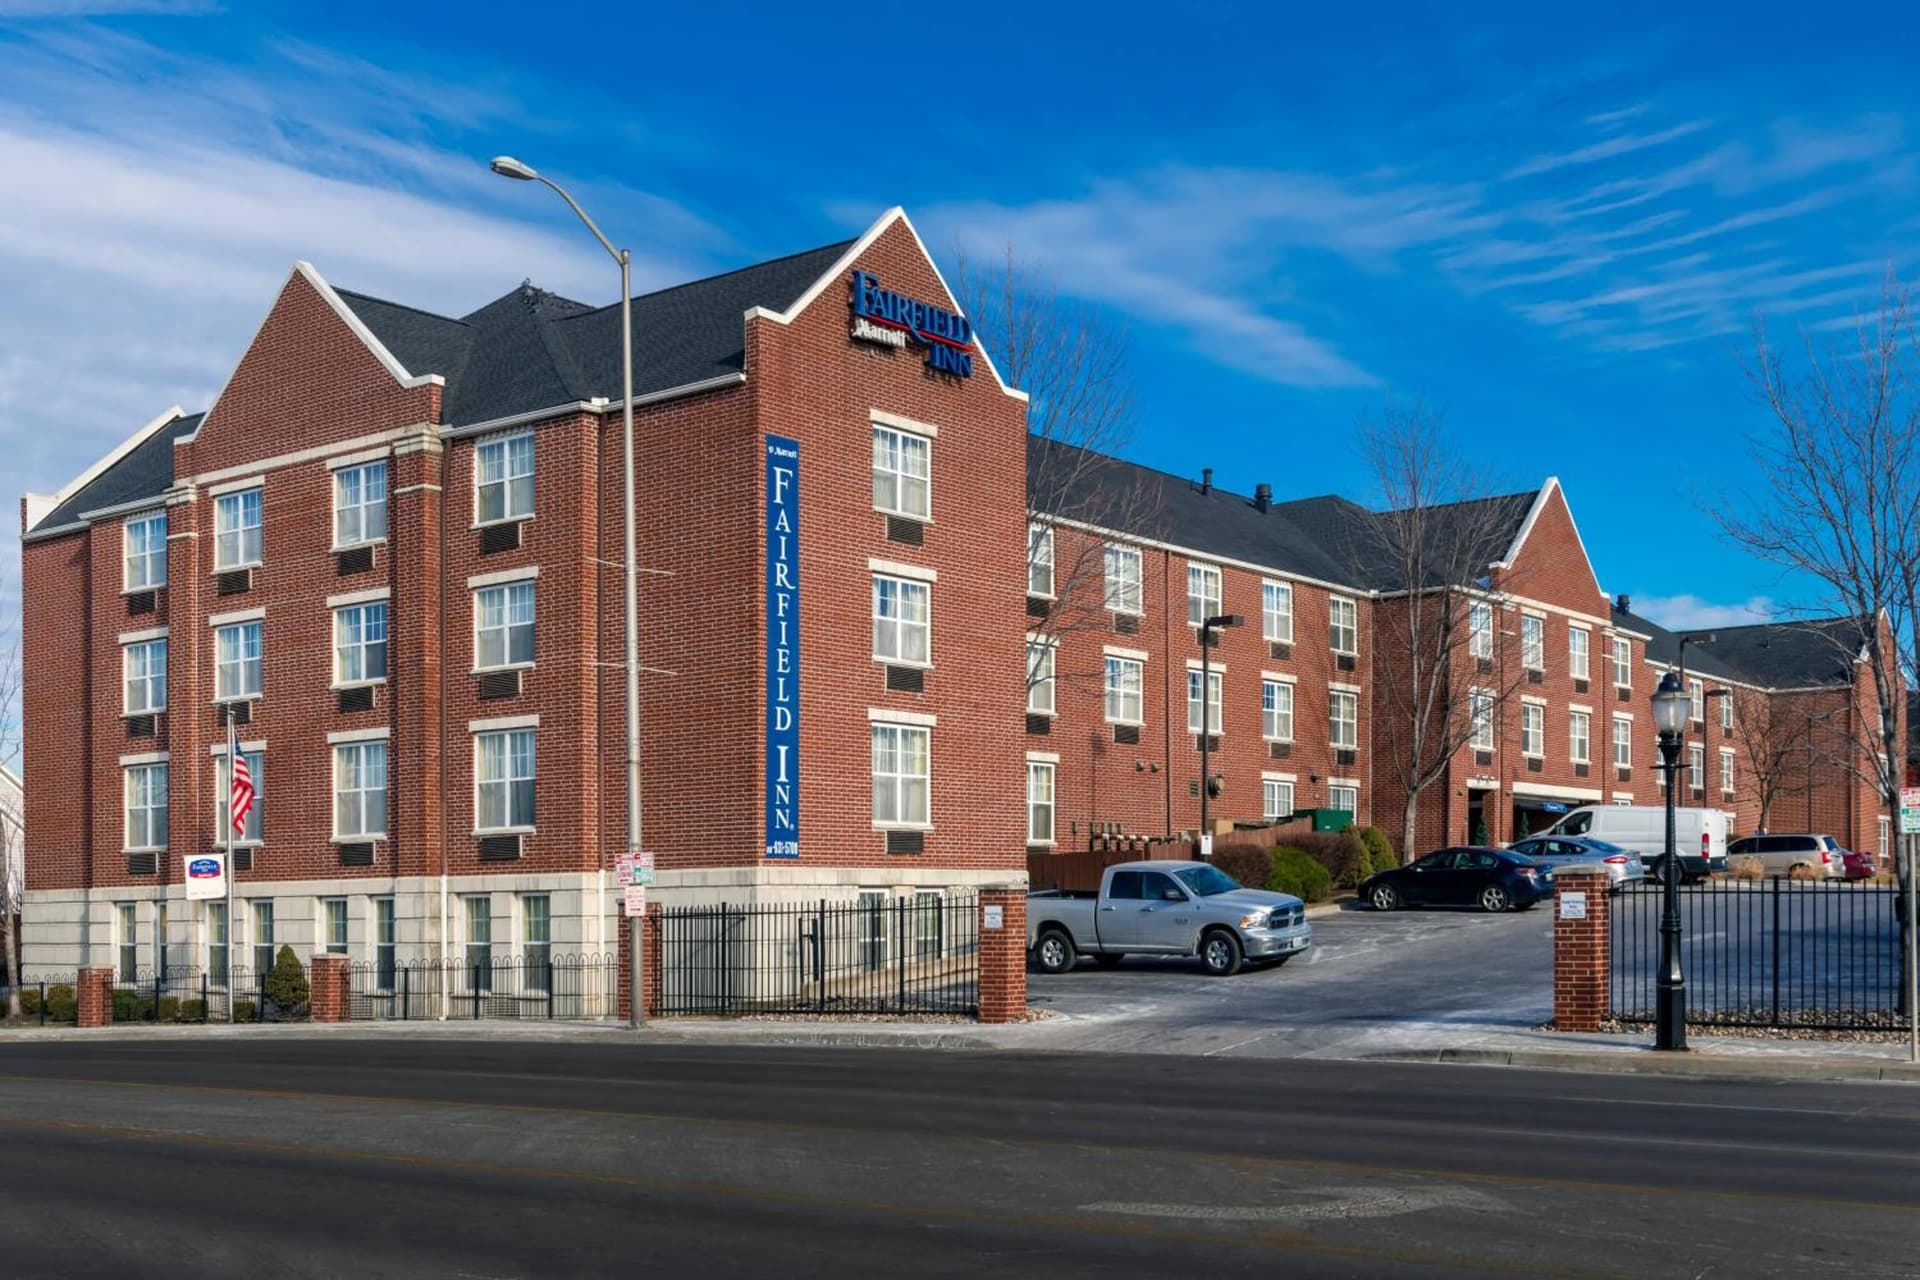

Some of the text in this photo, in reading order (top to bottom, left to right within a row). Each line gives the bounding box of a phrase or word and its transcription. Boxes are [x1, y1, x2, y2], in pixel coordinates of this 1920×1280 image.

[851, 319, 906, 348] Marriott
[852, 270, 973, 344] FAIRFIELD
[929, 343, 973, 377] INN
[773, 466, 796, 731] FAIRFIELD
